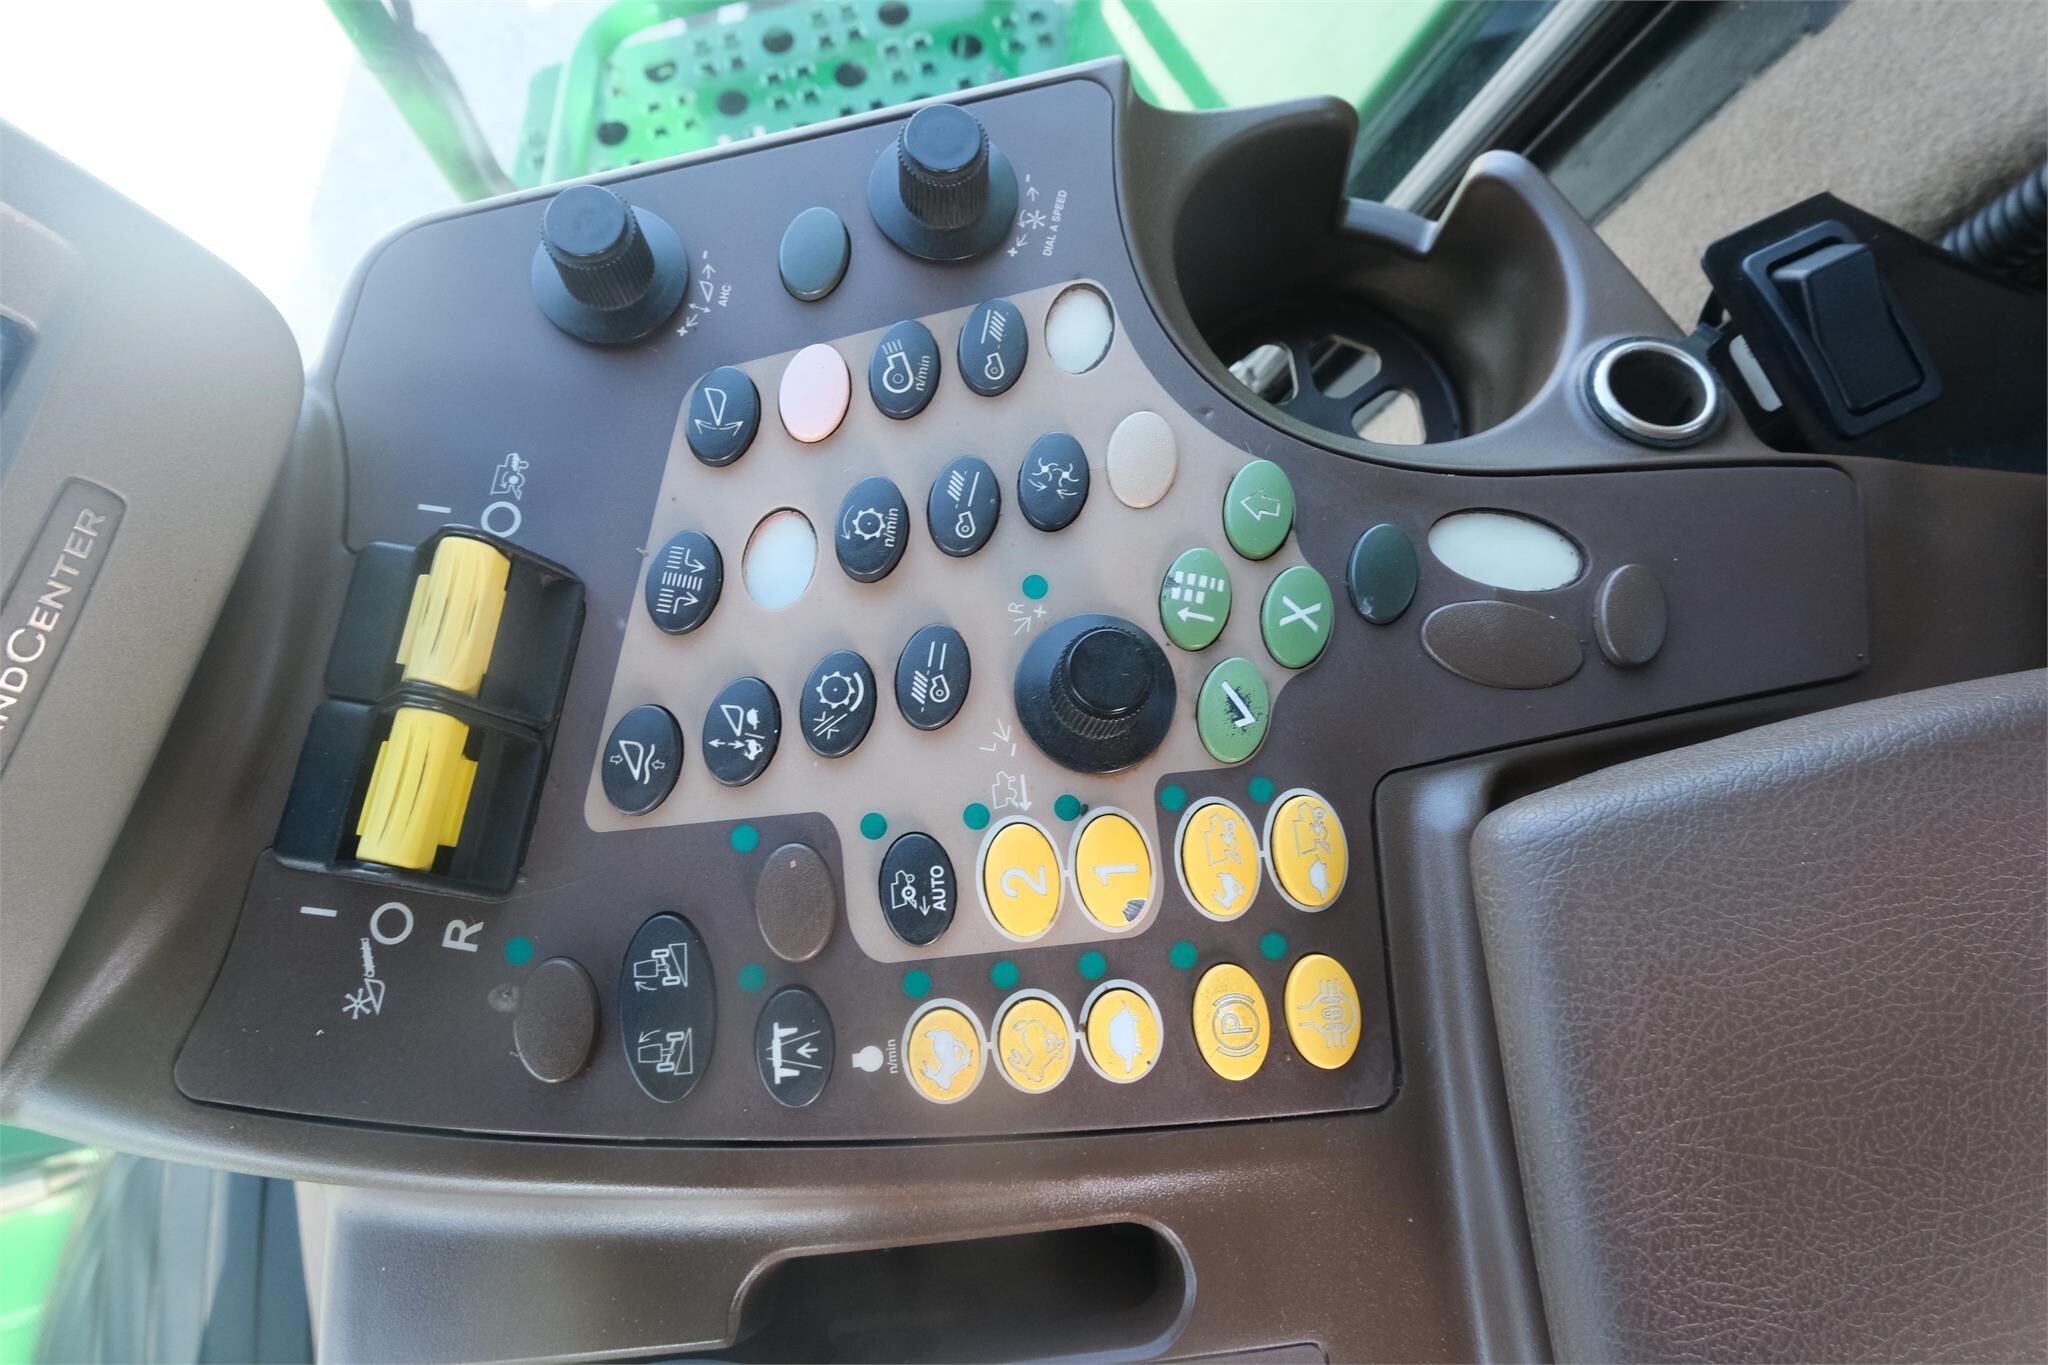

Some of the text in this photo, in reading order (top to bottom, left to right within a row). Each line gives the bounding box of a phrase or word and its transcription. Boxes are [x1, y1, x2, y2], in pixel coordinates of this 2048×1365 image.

[1042, 189, 1067, 257] DIAL A SPEED
[717, 283, 732, 307] AHC
[915, 355, 931, 391] n/min
[884, 507, 899, 548] n/min
[0, 507, 106, 730] NDCENTER
[930, 865, 946, 911] AUTO
[1000, 865, 1047, 898] 2
[1092, 864, 1139, 887] 1
[442, 919, 484, 952] R
[887, 1038, 899, 1075] n/min
